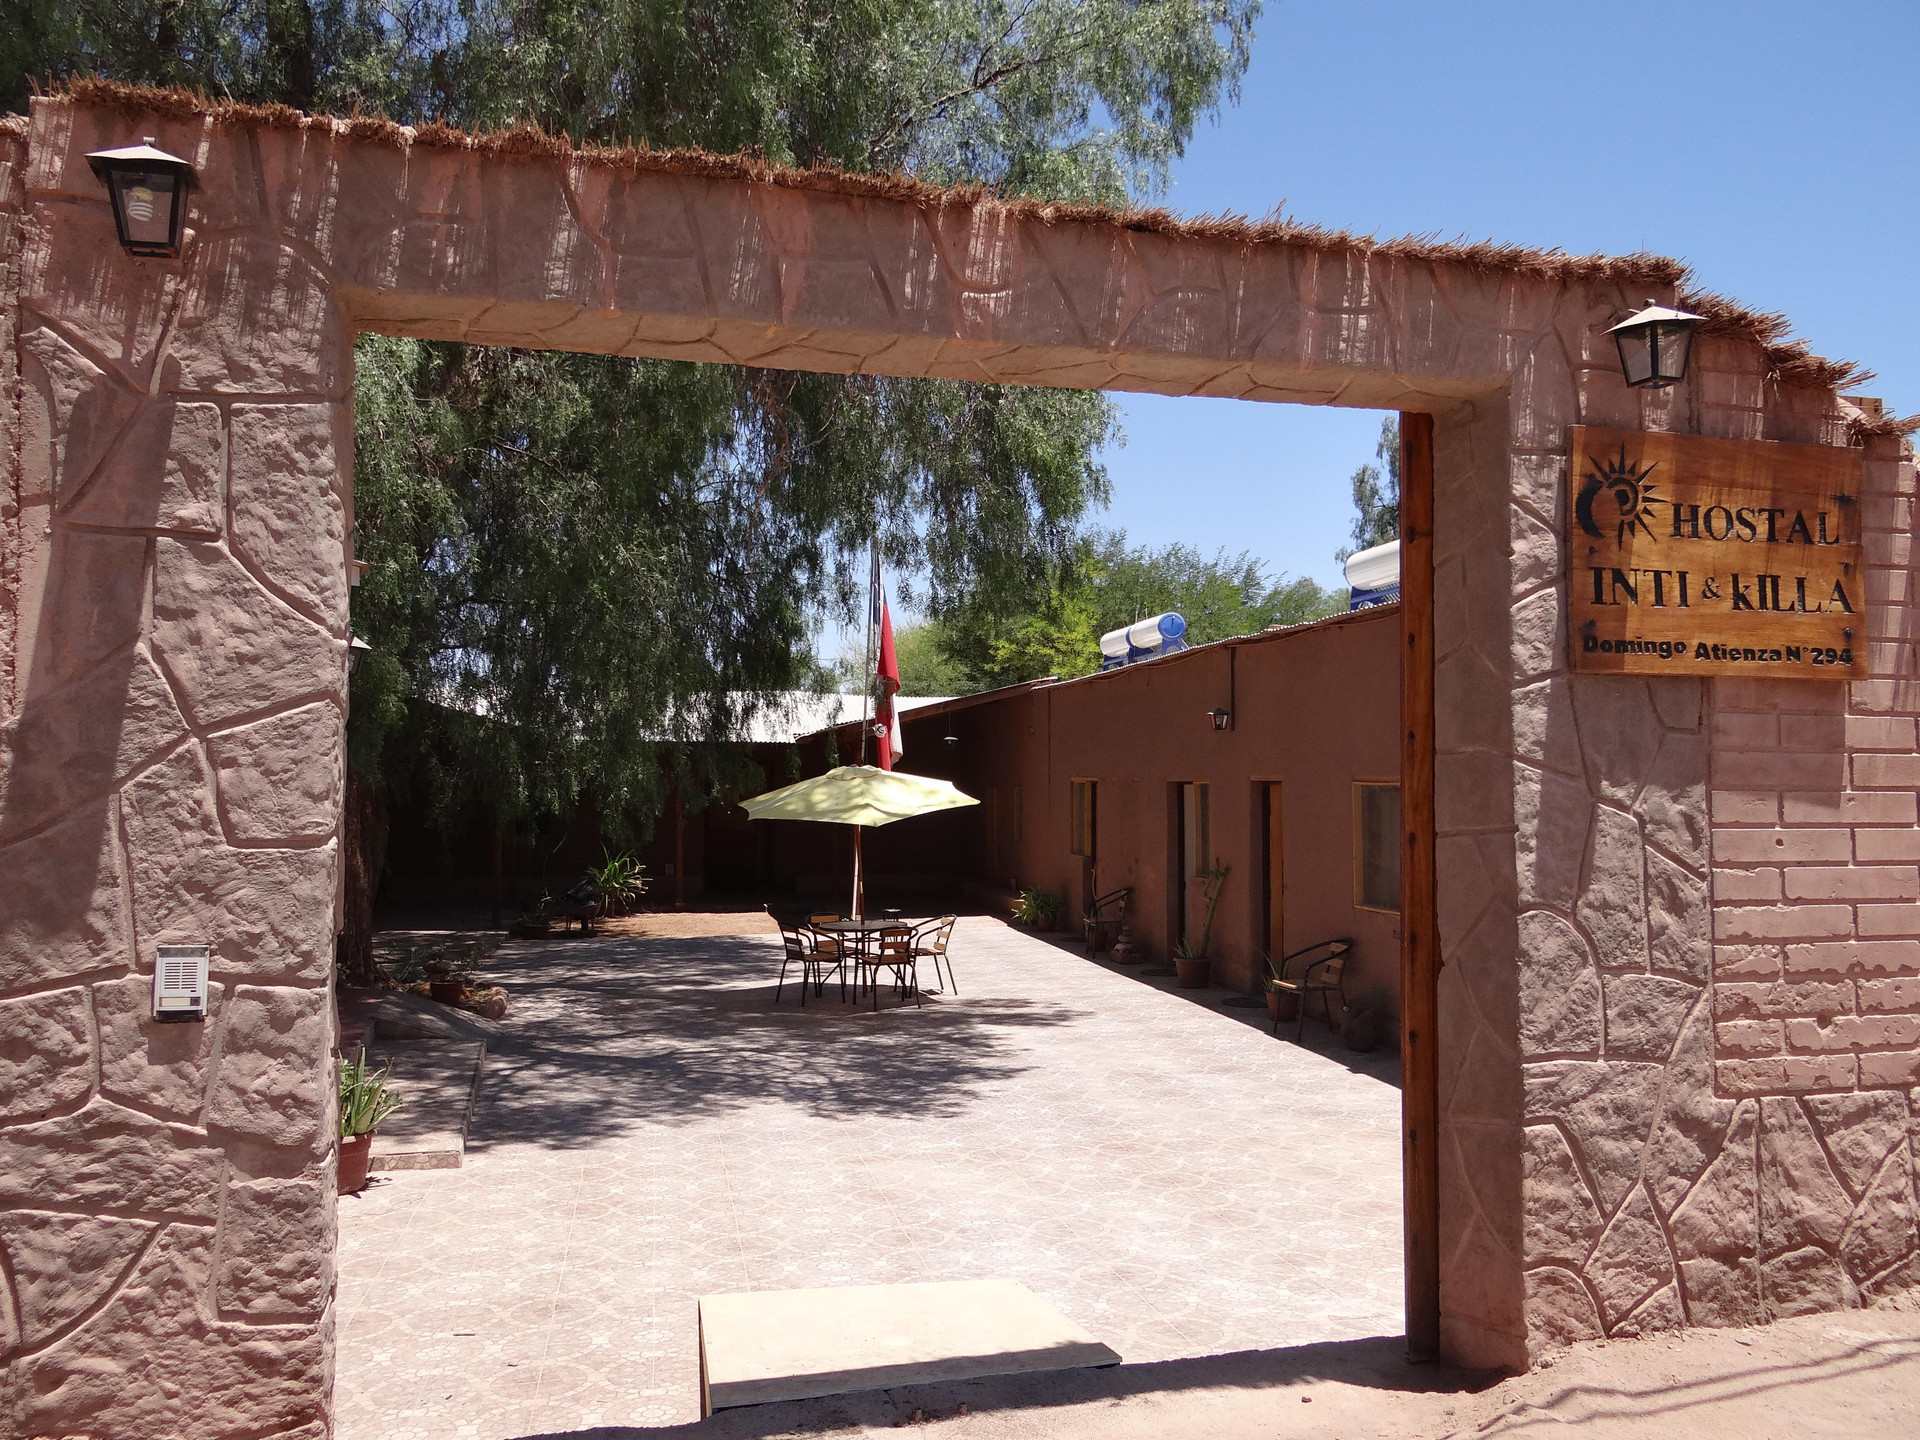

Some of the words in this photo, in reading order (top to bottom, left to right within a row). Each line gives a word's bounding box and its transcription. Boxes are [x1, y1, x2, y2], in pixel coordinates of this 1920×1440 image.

[1670, 503, 1840, 545] HOSTAL
[1588, 566, 1690, 608] INTI
[1702, 576, 1721, 600] &
[1583, 635, 1687, 660] Domingo
[1695, 642, 1782, 662] Atienza
